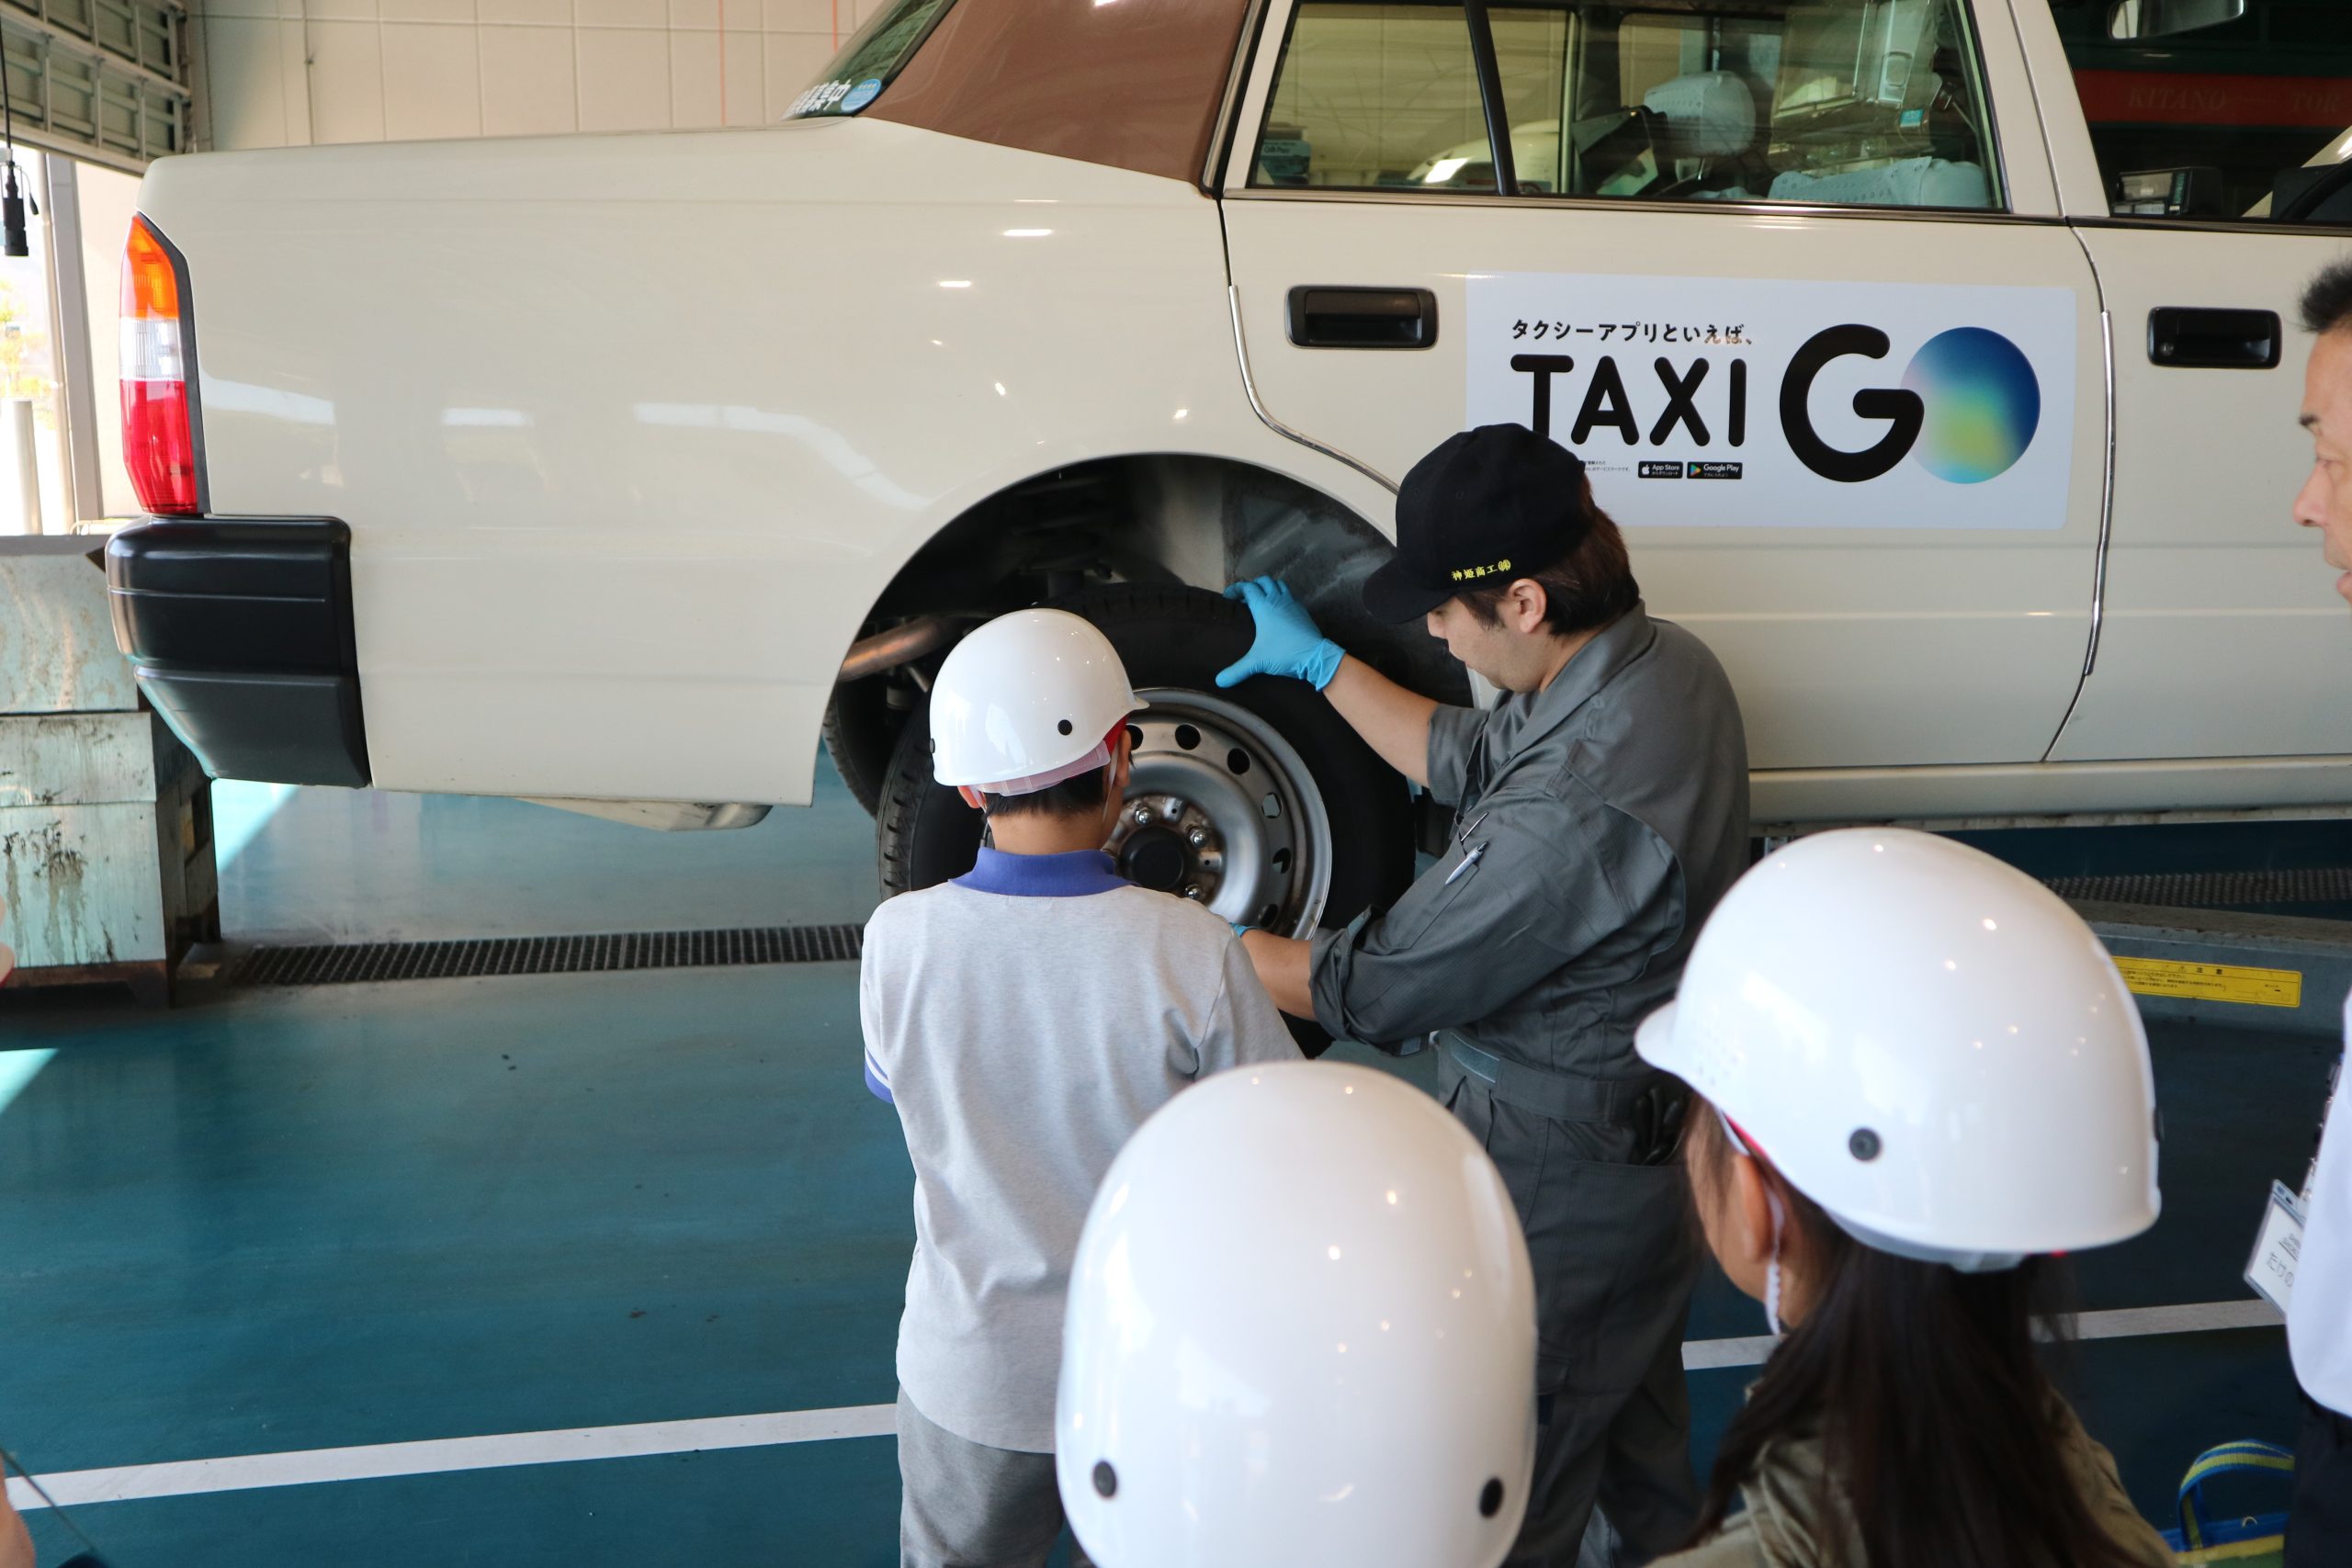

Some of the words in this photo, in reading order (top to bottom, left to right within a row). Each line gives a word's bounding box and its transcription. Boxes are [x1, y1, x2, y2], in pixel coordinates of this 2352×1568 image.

[2128, 87, 2226, 110] KITANO
[1512, 319, 1753, 345] タクシーアプリといえば、
[1510, 354, 1747, 447] TAXI
[1703, 463, 1725, 472] Google
[1726, 464, 1740, 472] Play
